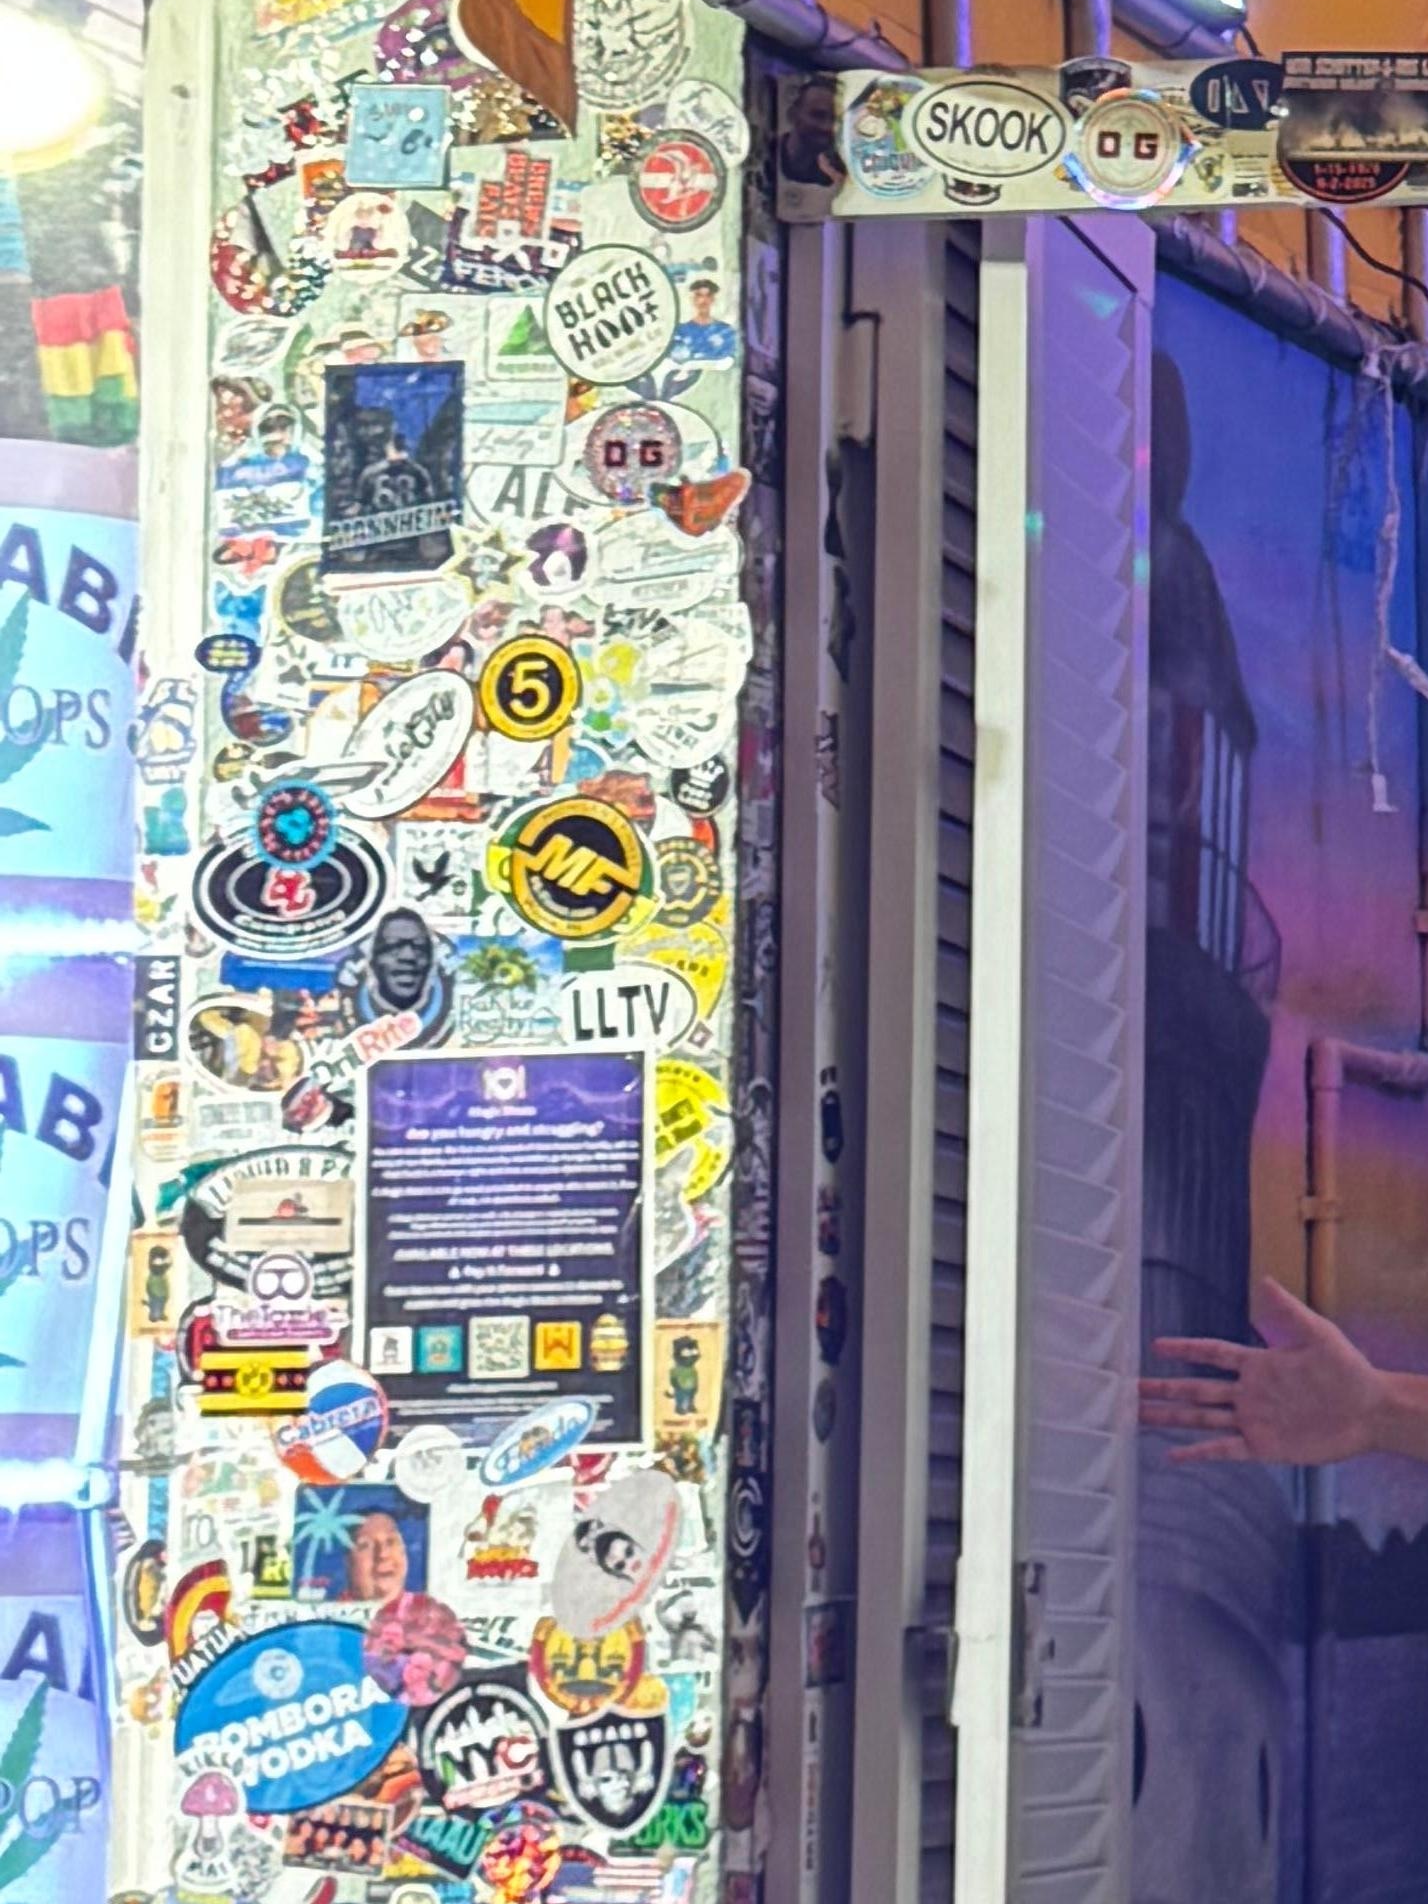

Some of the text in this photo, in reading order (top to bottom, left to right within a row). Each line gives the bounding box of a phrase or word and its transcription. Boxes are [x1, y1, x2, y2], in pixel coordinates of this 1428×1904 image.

[926, 100, 1053, 155] SKOOK
[555, 263, 654, 332] BLACK
[506, 660, 552, 720] 5
[572, 983, 669, 1041] LLTV
[241, 1720, 376, 1788] VODKA
